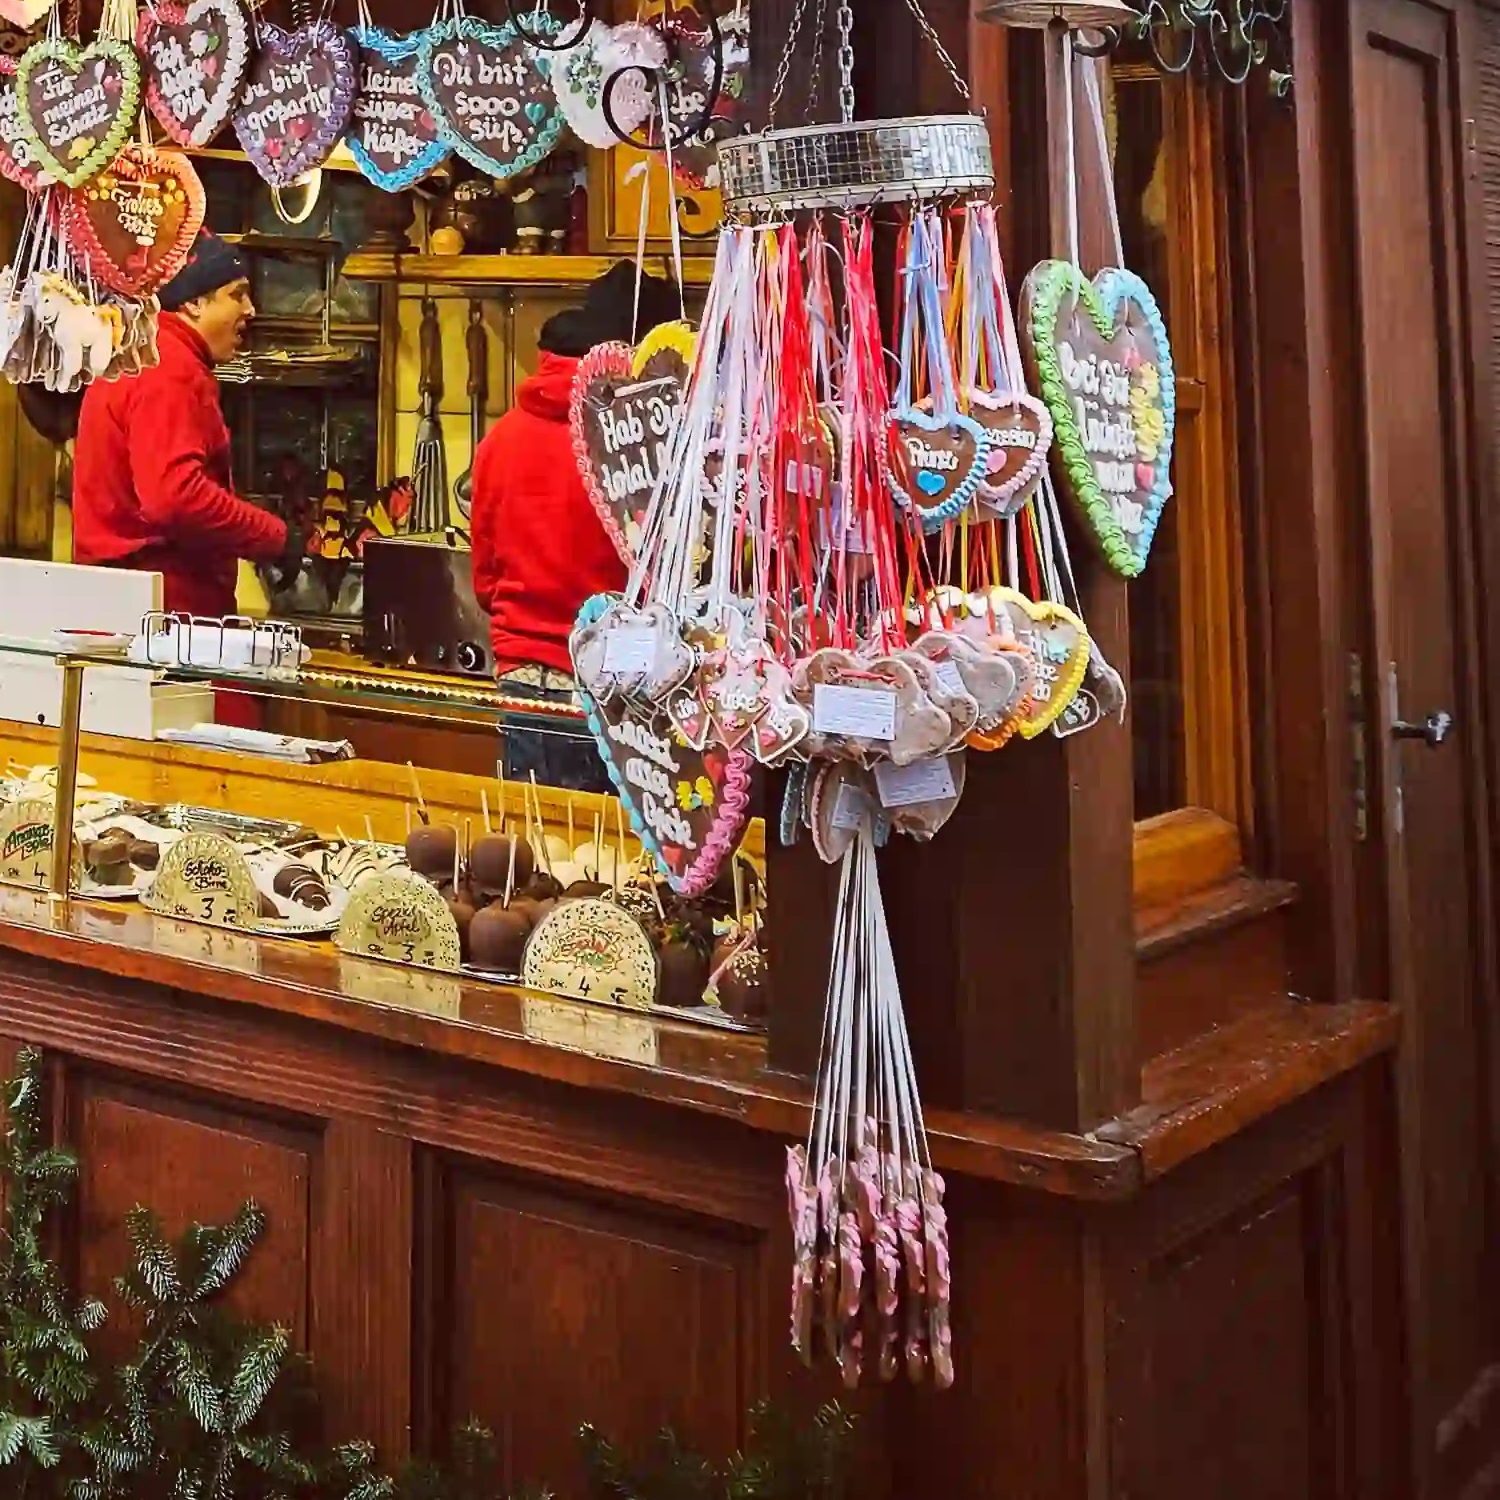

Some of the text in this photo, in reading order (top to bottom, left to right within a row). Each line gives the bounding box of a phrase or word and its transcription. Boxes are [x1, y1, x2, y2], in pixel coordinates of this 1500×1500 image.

[268, 62, 313, 94] bist
[433, 53, 528, 86] Du bist
[42, 84, 107, 125] meinen
[455, 91, 520, 117] sooo
[48, 103, 112, 147] Schatz
[601, 446, 655, 501] total
[200, 897, 215, 919] 3
[578, 975, 592, 996] 4
